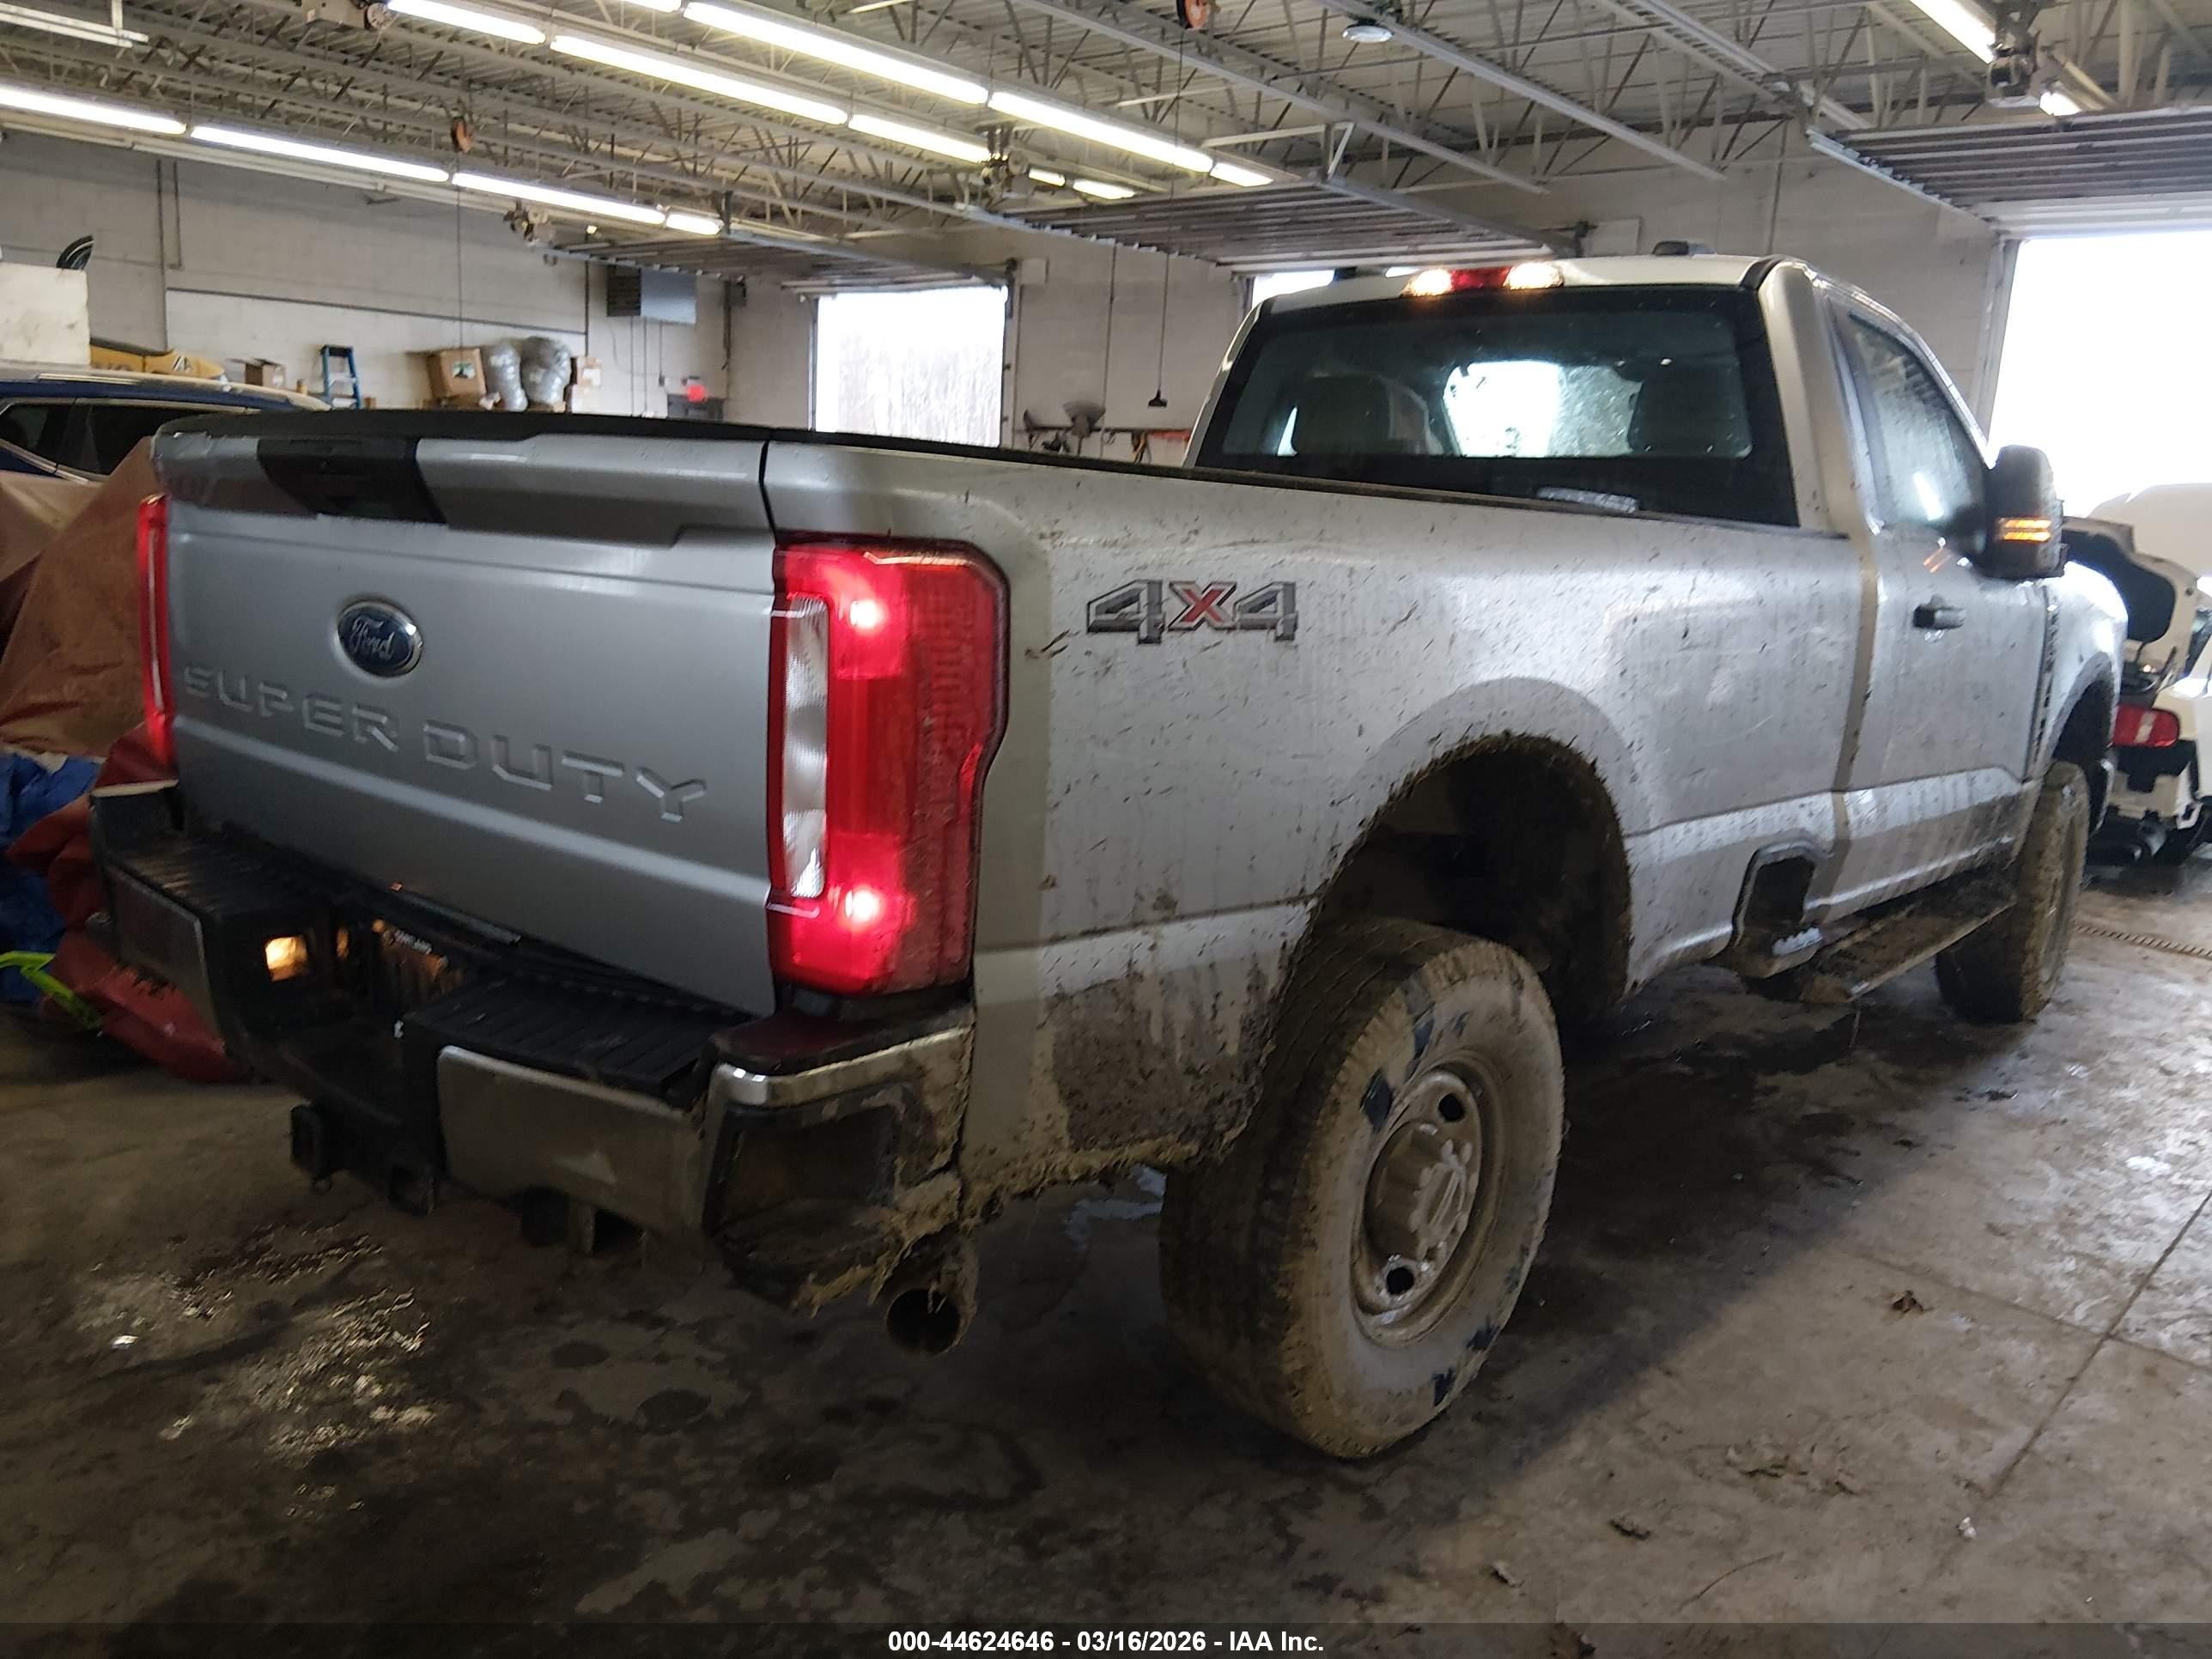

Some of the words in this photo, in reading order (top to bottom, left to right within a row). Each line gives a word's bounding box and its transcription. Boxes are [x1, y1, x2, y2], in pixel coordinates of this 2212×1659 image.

[349, 615, 396, 661] Ford
[183, 664, 399, 753] SUPER
[423, 720, 708, 823] DUTY
